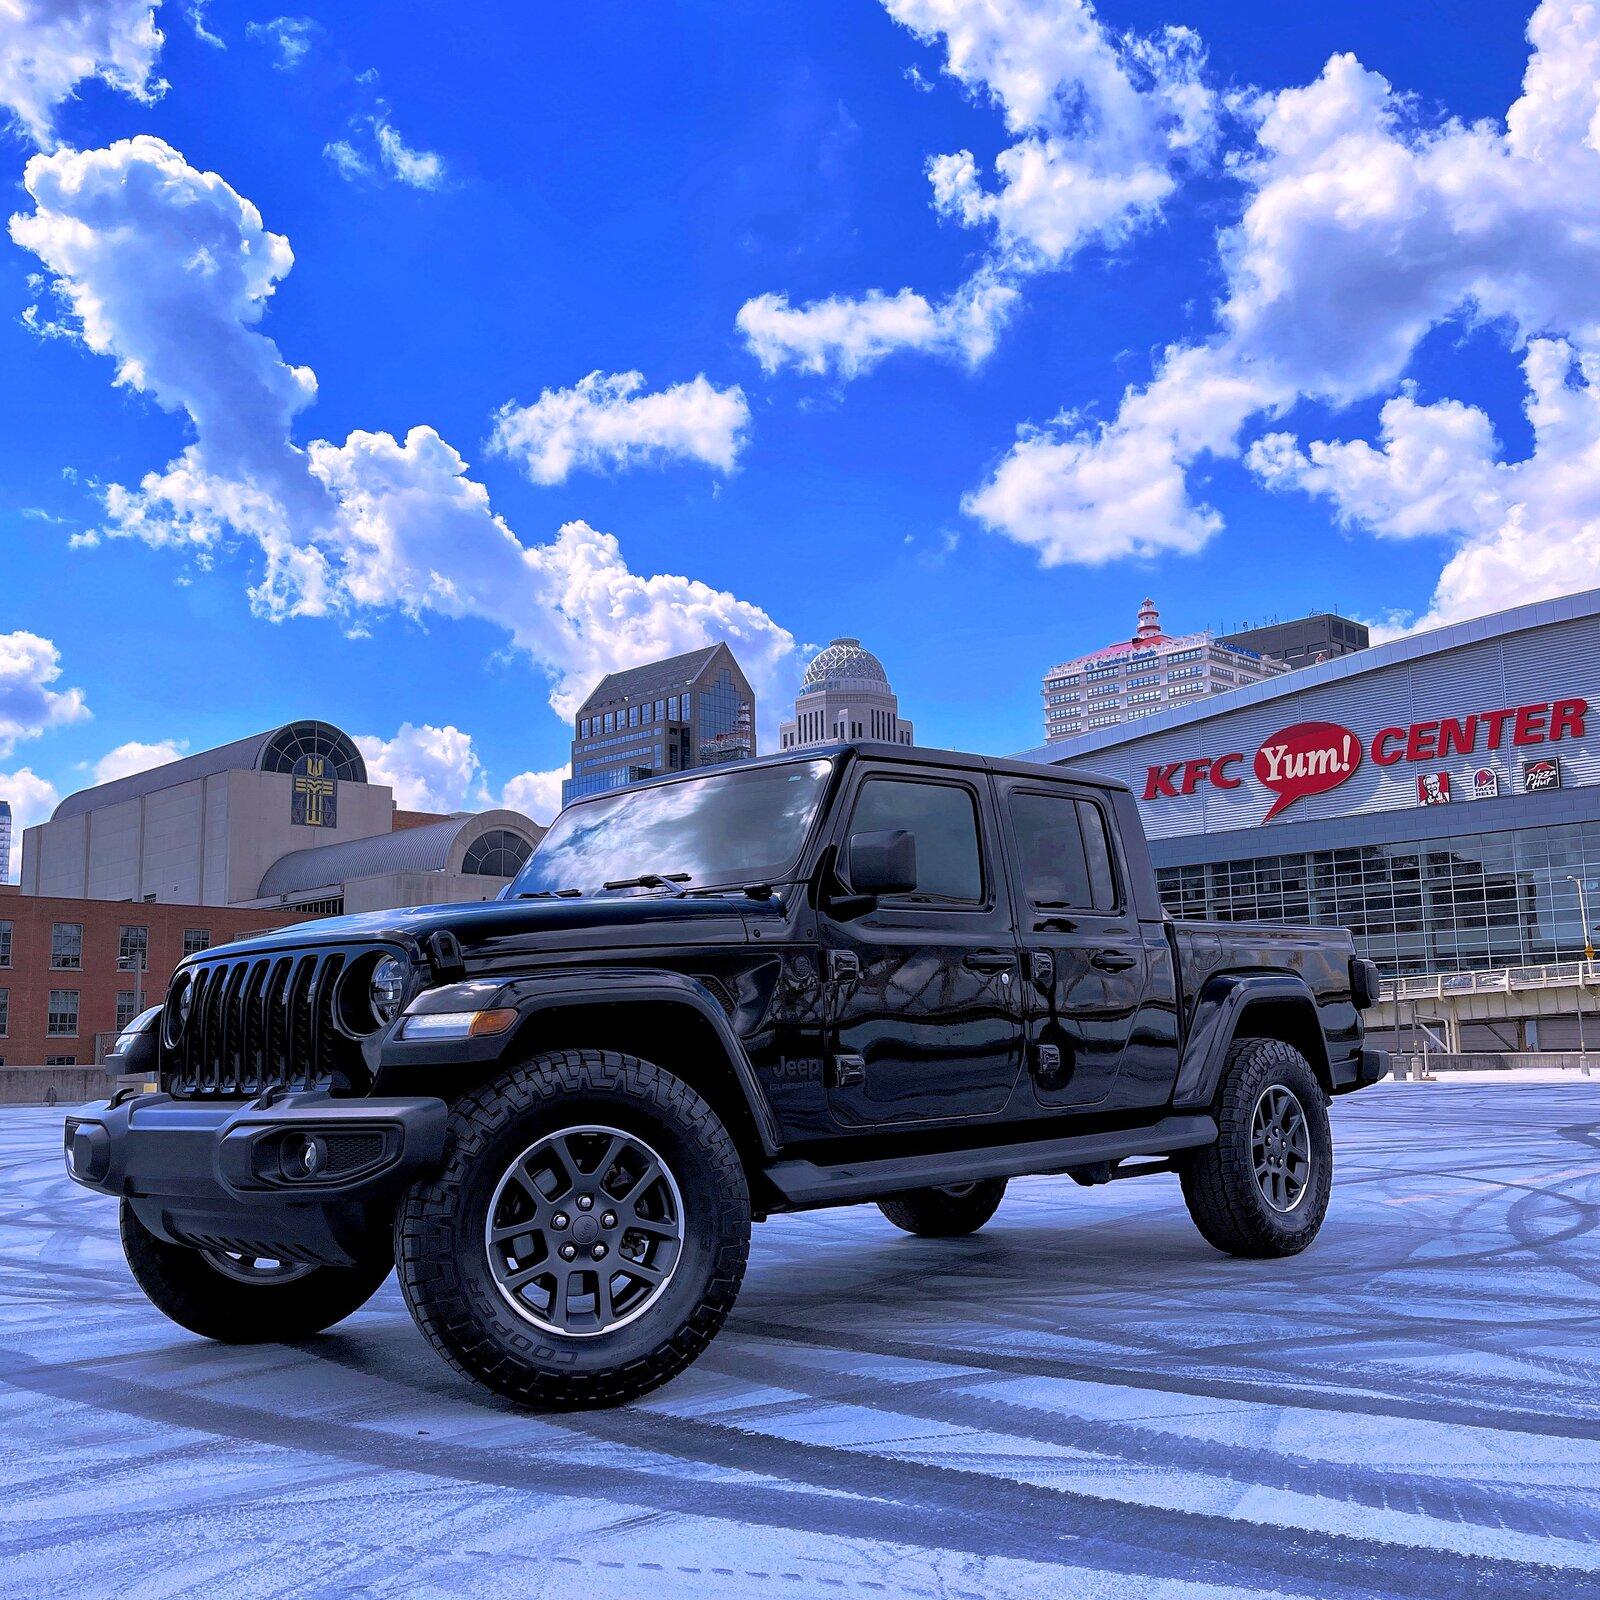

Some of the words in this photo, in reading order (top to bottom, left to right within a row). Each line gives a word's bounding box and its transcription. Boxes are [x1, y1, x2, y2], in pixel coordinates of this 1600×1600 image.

[1132, 650, 1156, 660] Bank
[1141, 752, 1244, 800] KFC
[1260, 734, 1351, 782] Yum!
[1370, 697, 1588, 766] CENTER
[1526, 770, 1556, 786] Pizza
[1532, 777, 1553, 789] Hut
[772, 1055, 818, 1079] Jeep
[466, 1275, 579, 1364] COOPER
